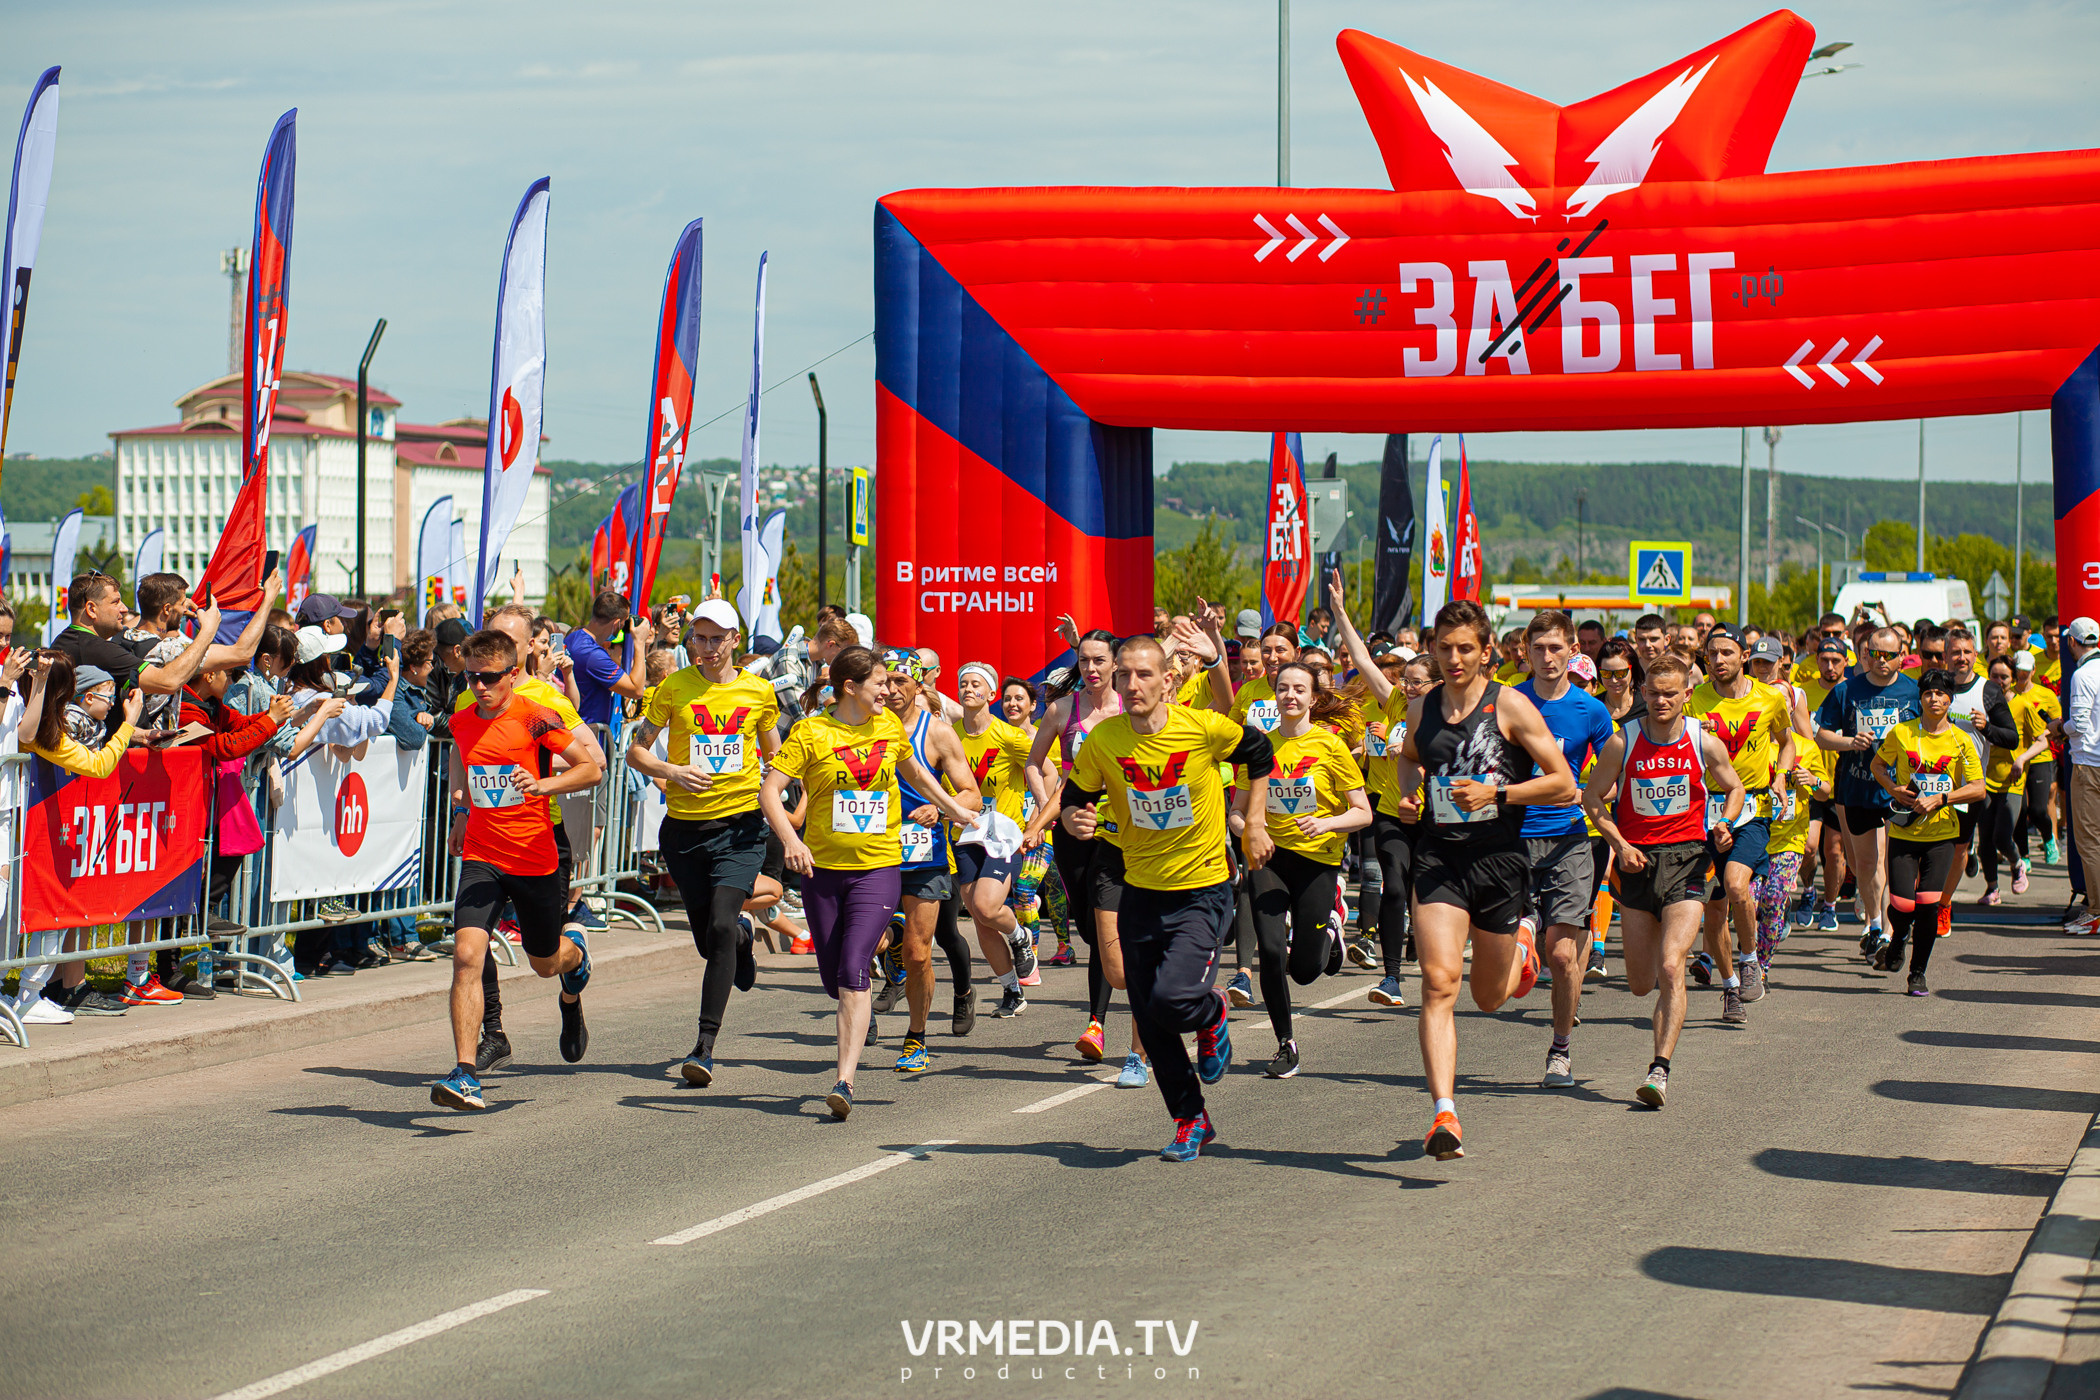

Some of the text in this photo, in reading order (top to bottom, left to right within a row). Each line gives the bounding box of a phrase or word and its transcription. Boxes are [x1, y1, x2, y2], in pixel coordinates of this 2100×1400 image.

[897, 561, 1058, 586] В ритме всей
[920, 591, 1034, 613] СТРАНЫ!
[1252, 707, 1281, 718] 1010
[694, 713, 745, 728] ONE
[1860, 715, 1897, 726] 10136
[695, 744, 740, 756] 10168
[1728, 740, 1757, 752] UN
[970, 756, 995, 768] NE
[1283, 763, 1311, 774] NE
[1636, 757, 1692, 771] RUSSIA
[836, 768, 890, 784] RUN
[1123, 763, 1186, 783] ONE
[1267, 786, 1312, 798] 10169
[1637, 784, 1687, 800] 10068
[1920, 781, 1951, 792] 0183
[838, 800, 885, 814] 10175
[1132, 794, 1187, 813] 10186
[340, 794, 363, 835] hh
[902, 832, 929, 845] 135
